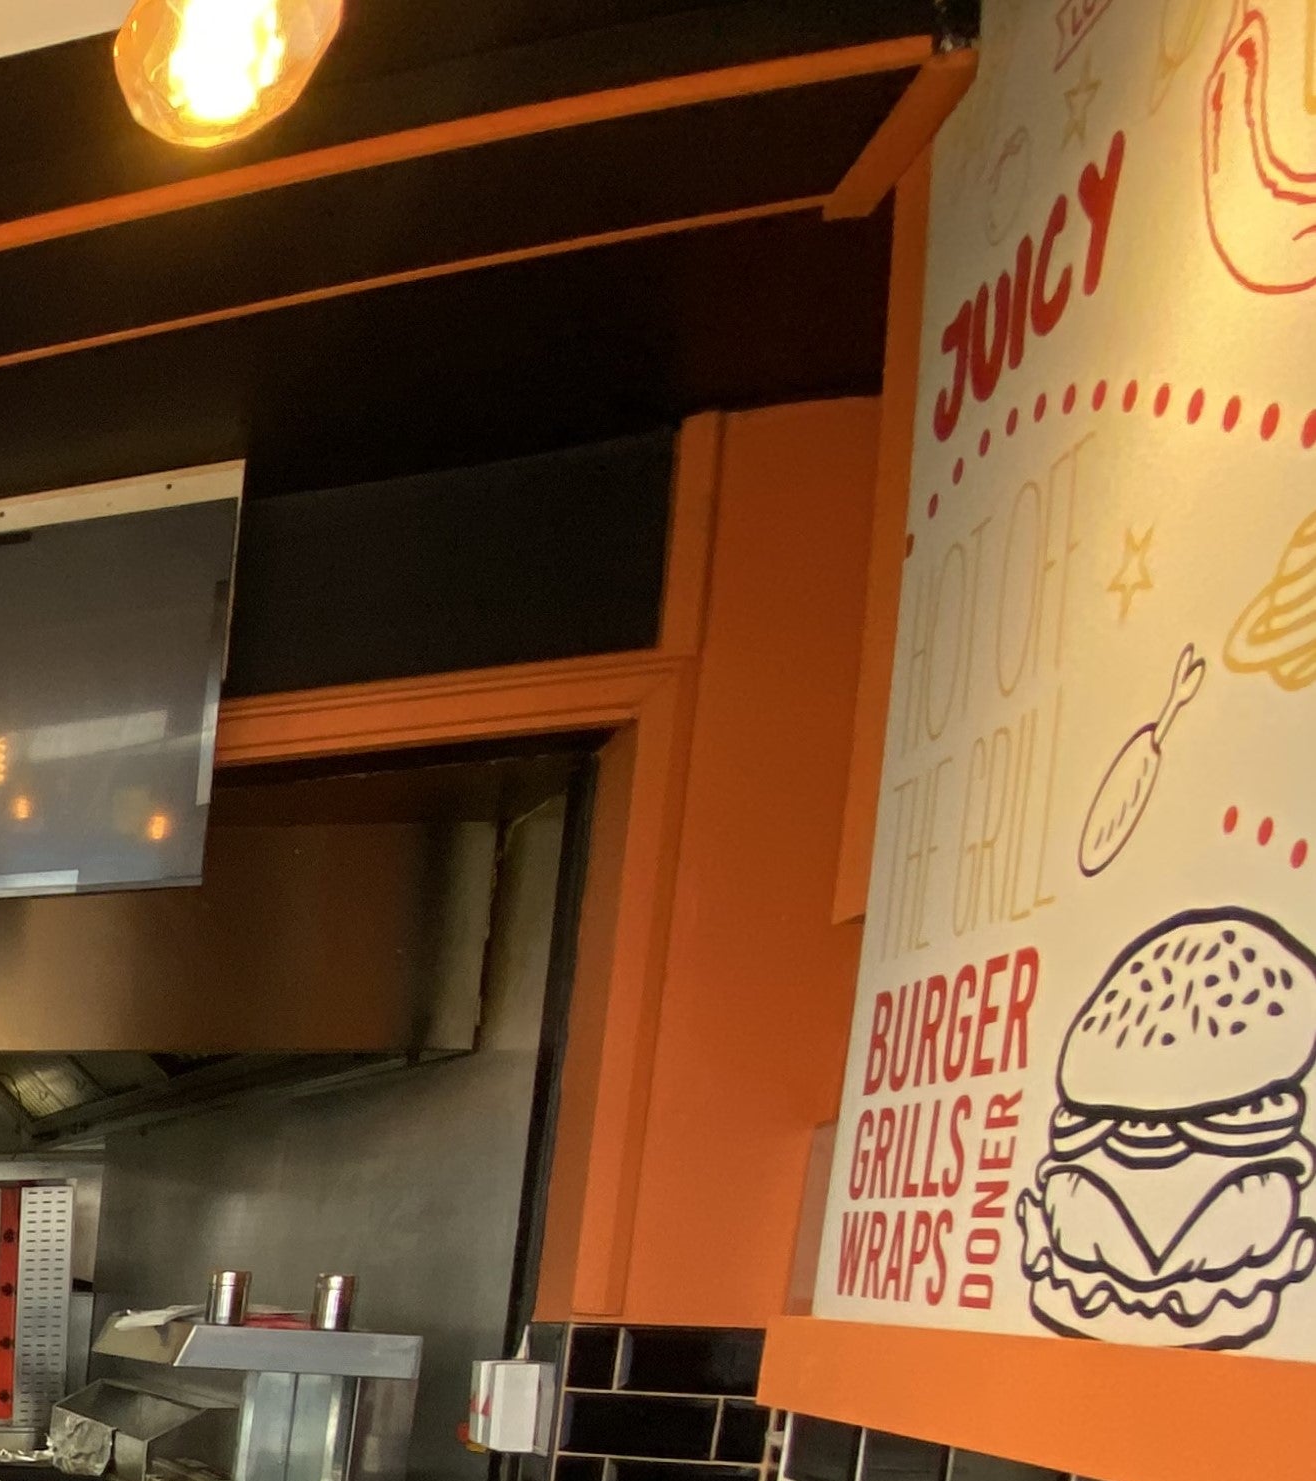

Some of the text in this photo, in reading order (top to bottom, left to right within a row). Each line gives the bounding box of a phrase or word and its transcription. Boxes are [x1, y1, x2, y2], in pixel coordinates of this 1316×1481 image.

[934, 130, 1125, 442] JUICY
[996, 430, 1097, 698] OFF
[879, 682, 1063, 963] THE GRILL
[863, 945, 1040, 1097] BURGER
[836, 1208, 954, 1307] WRAPS
[848, 1094, 972, 1201] GRILLS
[957, 1087, 1024, 1310] DONER
